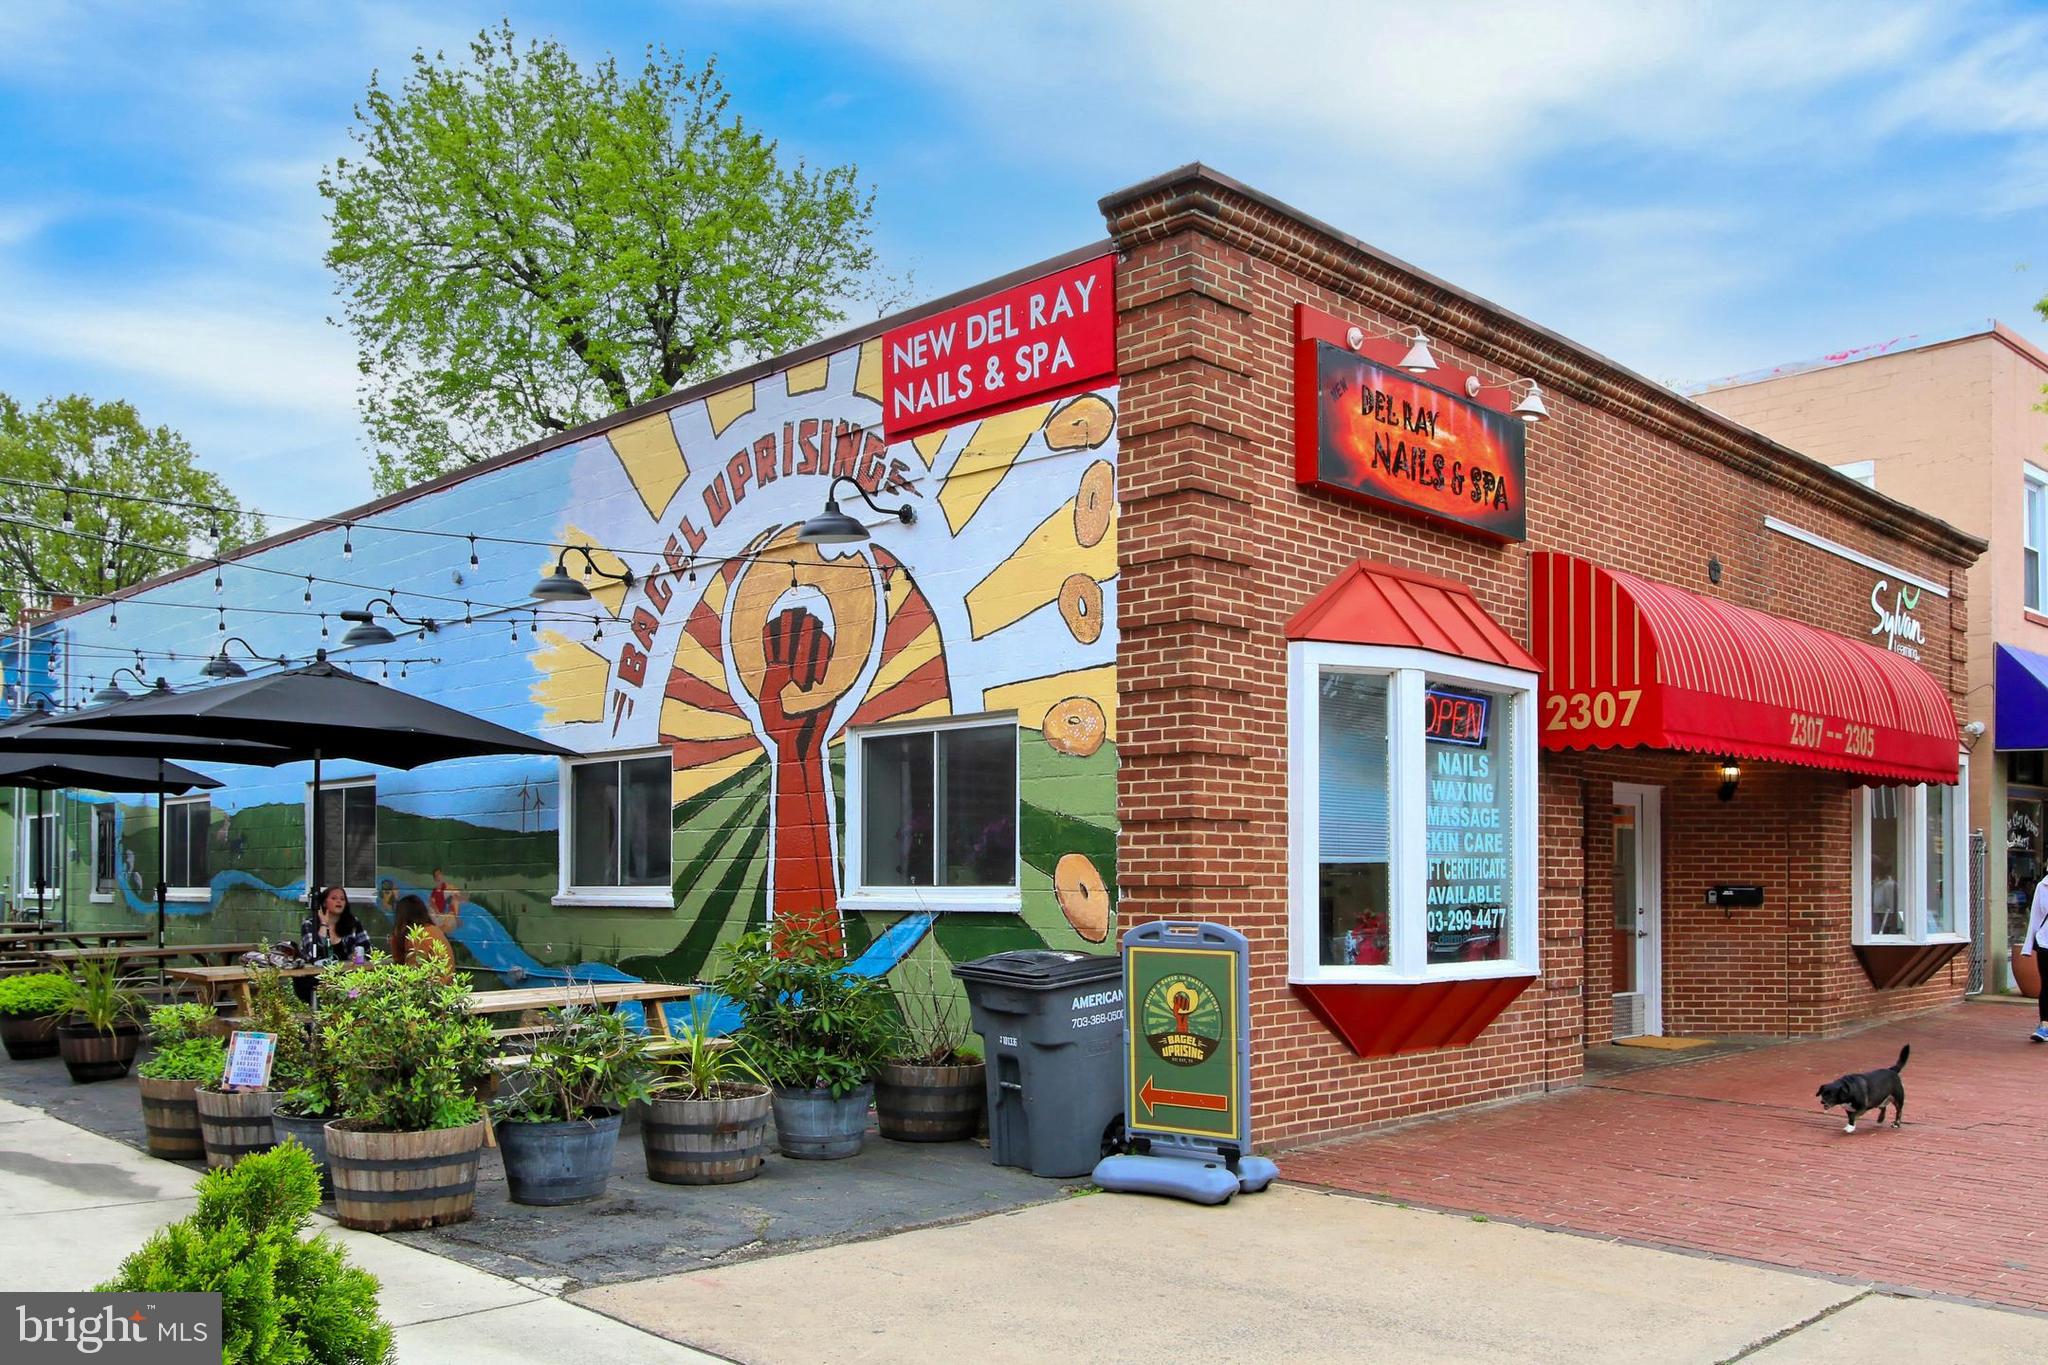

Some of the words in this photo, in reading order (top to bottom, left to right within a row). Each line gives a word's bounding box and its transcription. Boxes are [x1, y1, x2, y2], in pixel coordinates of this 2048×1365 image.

[893, 322, 957, 374] NEW
[967, 304, 1018, 349] DEL
[1030, 275, 1096, 329] RAY
[894, 364, 973, 419] NAILS
[984, 356, 1005, 391] &
[1016, 336, 1075, 382] SPA
[1330, 377, 1348, 401] NEW
[1361, 384, 1399, 426] DEL
[1403, 400, 1439, 439] RAY
[1371, 432, 1445, 490] NAILS
[1451, 461, 1465, 495] &
[1470, 466, 1509, 511] SPA
[618, 515, 707, 688] BAGEL
[702, 418, 887, 527] UPRISING
[1871, 580, 1925, 650] Sylvan
[1426, 696, 1482, 739] OPEN
[1546, 689, 1642, 731] 2307
[1790, 713, 1823, 749] 2307
[1845, 723, 1875, 757] 2305
[1438, 752, 1489, 777] NAILS
[1432, 780, 1494, 803] WAXING
[1427, 806, 1500, 828] MASSAGE
[1426, 831, 1459, 852] SKIN
[1464, 832, 1503, 853] CARE
[1426, 858, 1441, 880] IFT
[1443, 858, 1506, 880] CERTIFICATE
[1428, 885, 1502, 904] AVAILABLE
[1427, 908, 1506, 932] 03-299-4477
[1072, 989, 1124, 1010] AMERICAN
[1162, 1045, 1203, 1060] UPRISING
[1167, 1035, 1197, 1046] BAGEL
